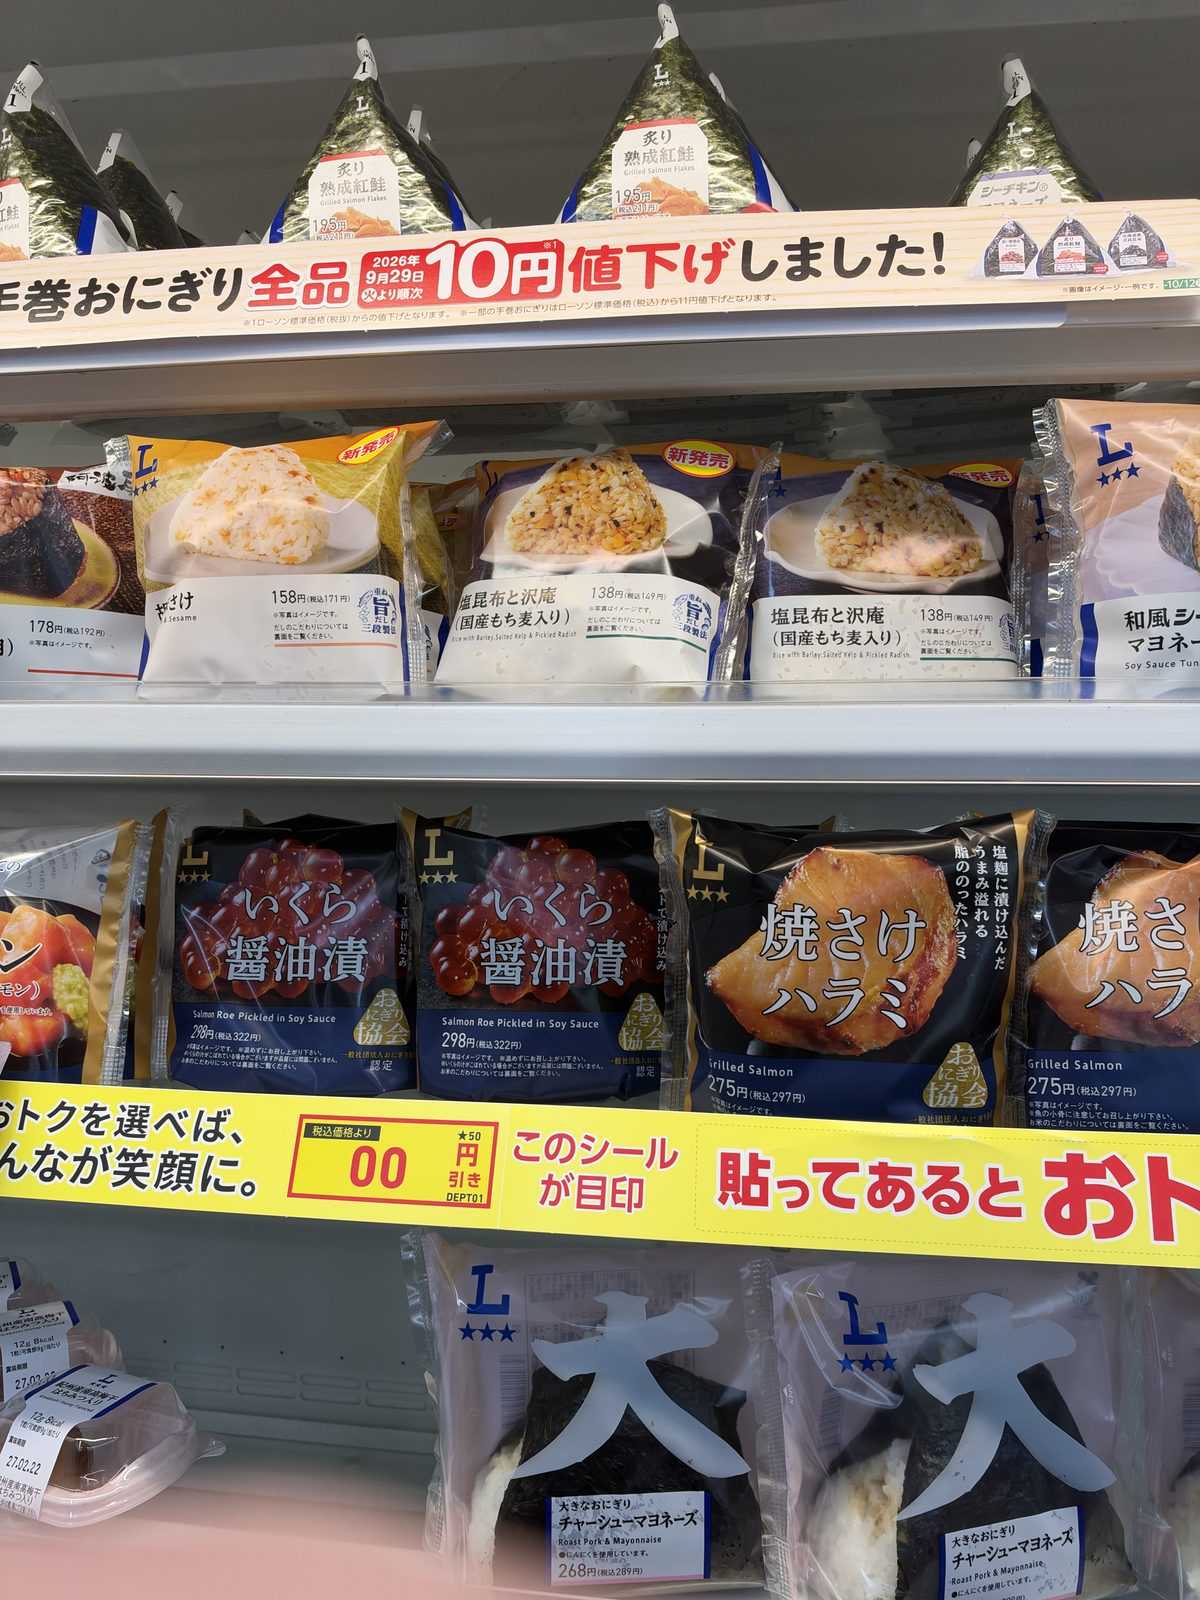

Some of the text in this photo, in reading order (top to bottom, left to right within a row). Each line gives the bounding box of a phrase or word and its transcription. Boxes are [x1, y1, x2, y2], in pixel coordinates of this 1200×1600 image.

[654, 64, 669, 80] L
[643, 129, 672, 147] 炙り
[1007, 122, 1021, 138] L
[624, 146, 695, 167] 熟成紅鮭
[337, 161, 364, 178] 炙り
[624, 165, 695, 176] Grilled Salmon Flakes
[319, 177, 387, 197] 熟成紅鮭
[615, 189, 651, 204] 195円
[313, 217, 347, 232] 195円
[373, 255, 420, 268] 2026年
[366, 270, 424, 285] 9月29日
[341, 430, 396, 461] 新発売
[1090, 422, 1134, 467] L
[134, 444, 159, 479] L
[668, 446, 731, 470] 新発売
[459, 586, 557, 611] 塩昆布と沢庵
[455, 608, 570, 631] (国産もち麦入り)
[771, 606, 885, 625] 塩昆布と沢庵
[535, 631, 556, 639] Pickled
[558, 630, 577, 638] Radish
[772, 629, 902, 647] (国産もち麦入り)
[772, 651, 910, 659] Rice with Kelp Pickled Radish
[1125, 662, 1142, 671] Soy
[1145, 661, 1176, 669] Sauce
[182, 838, 209, 866] L
[423, 829, 454, 866] L
[692, 840, 725, 881] L
[244, 882, 357, 926] いくら
[954, 845, 971, 960] 脂ののったハラミ
[973, 845, 989, 940] うまみ溢れる
[493, 882, 613, 927] いくら
[992, 845, 1009, 970] 塩麹に漬け込んだ
[759, 902, 927, 963] 焼さけ
[1078, 897, 1188, 957] 焼さ
[225, 934, 369, 982] 醤油漬
[480, 937, 629, 987] 醤油漬
[761, 976, 909, 1030] ハラミ
[1084, 966, 1195, 1020] ハラ
[217, 1010, 235, 1020] Roe
[238, 1011, 274, 1022] Pickled
[276, 1014, 286, 1023] in
[288, 1014, 305, 1025] Soy
[307, 1014, 336, 1023] Sauce
[442, 1017, 599, 1030] Salmon Roe Pickled in Soy Sauce
[370, 1060, 393, 1071] 認定
[636, 1066, 656, 1078] 認定
[748, 1065, 793, 1077] Salmon
[1028, 1060, 1122, 1071] Grilled Salmon
[312, 1125, 373, 1139] 税込価格より
[456, 1143, 479, 1166] 円
[513, 1131, 679, 1169] このシール
[350, 1145, 407, 1189] 00
[448, 1171, 482, 1188] 引き
[446, 1192, 484, 1203] DEPT01
[539, 1171, 645, 1213] が目印
[467, 1264, 510, 1315] L
[837, 1291, 888, 1345] L
[510, 1291, 751, 1481] 大
[896, 1292, 1118, 1520] 大
[30, 1411, 65, 1428] 12g 8kcal
[6, 1455, 41, 1475] 27.02.22
[559, 1499, 631, 1512] 大きなおにぎり
[559, 1510, 699, 1531] チャーシューマヨネーズ
[558, 1535, 662, 1546] Roast Pork & Mayonnaise
[952, 1525, 1015, 1549] 大きなおにぎり
[952, 1526, 1074, 1570] チャーシューマヨネーズ
[951, 1560, 1043, 1585] Roast Pork & Mayonnaise
